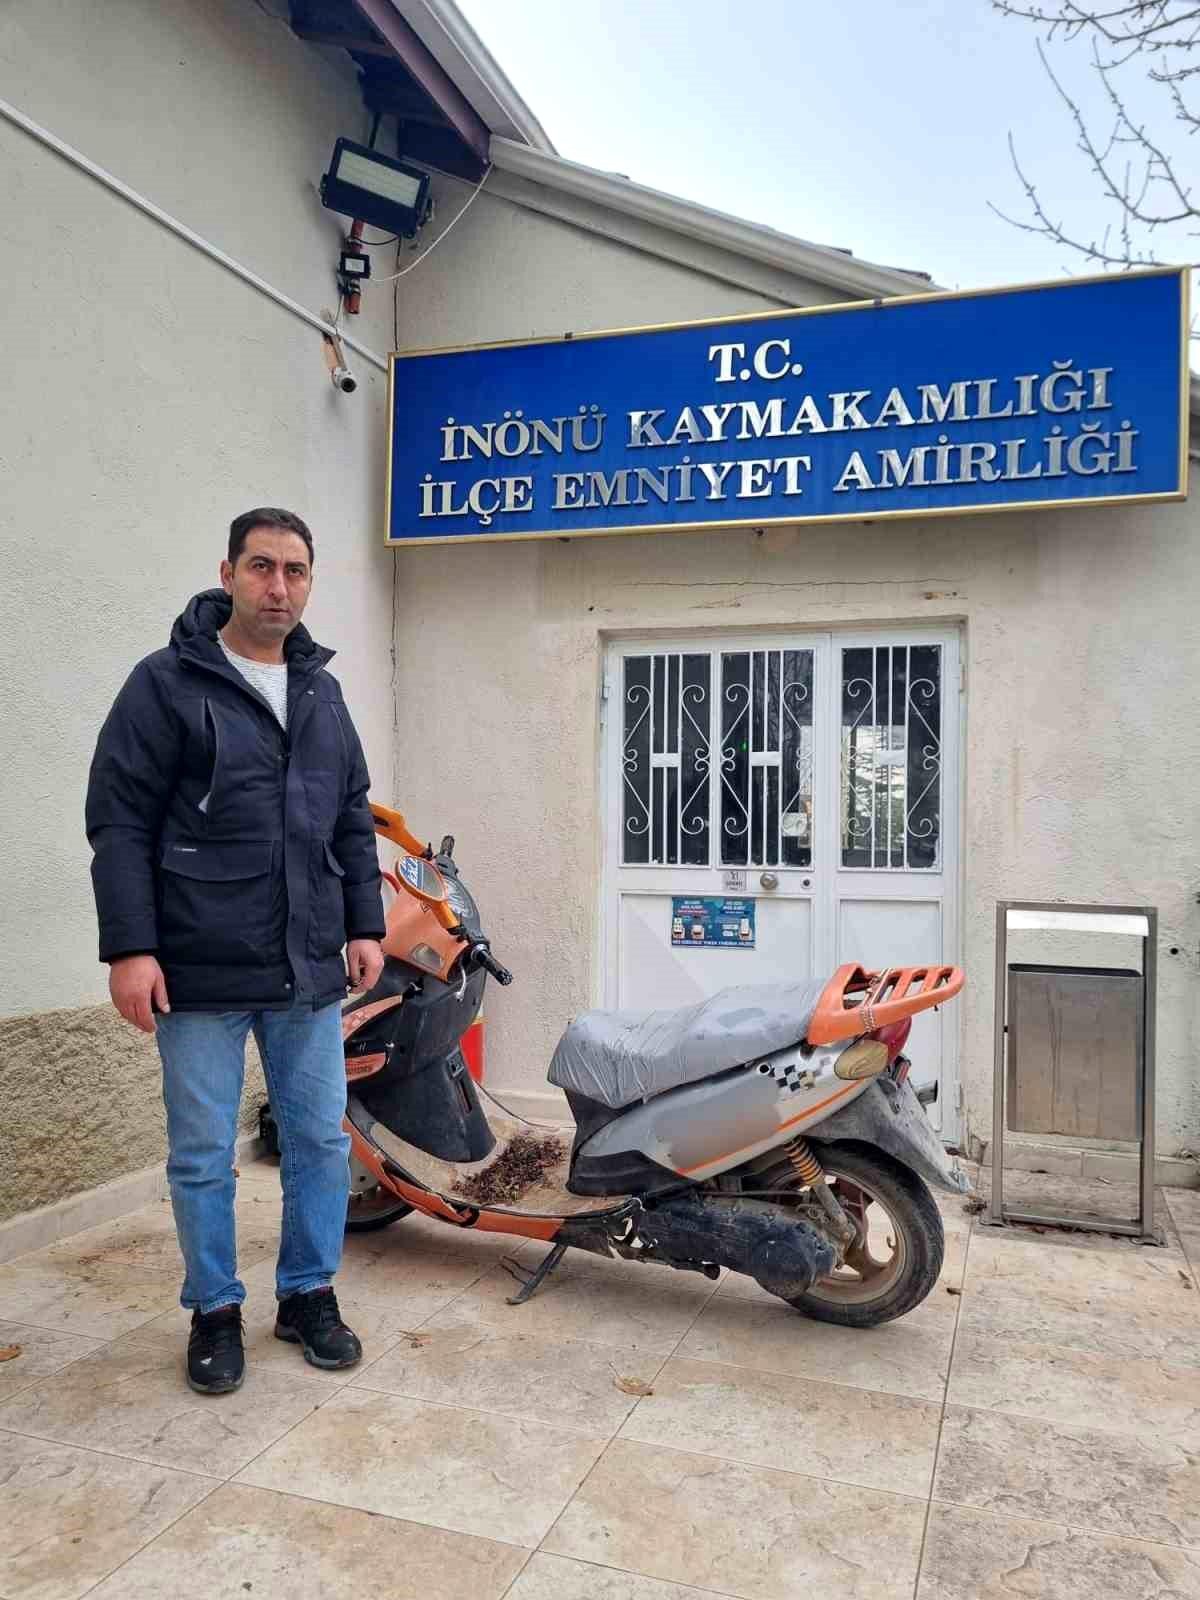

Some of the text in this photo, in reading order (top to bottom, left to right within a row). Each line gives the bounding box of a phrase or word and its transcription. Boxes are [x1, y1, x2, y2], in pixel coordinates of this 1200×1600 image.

[440, 359, 1113, 462] İNÖNÜ KAYMAKAMLIĞI
[708, 338, 804, 383] T.C.
[418, 419, 1140, 525] İLÇE EMNİYET AMİRLİĞİ
